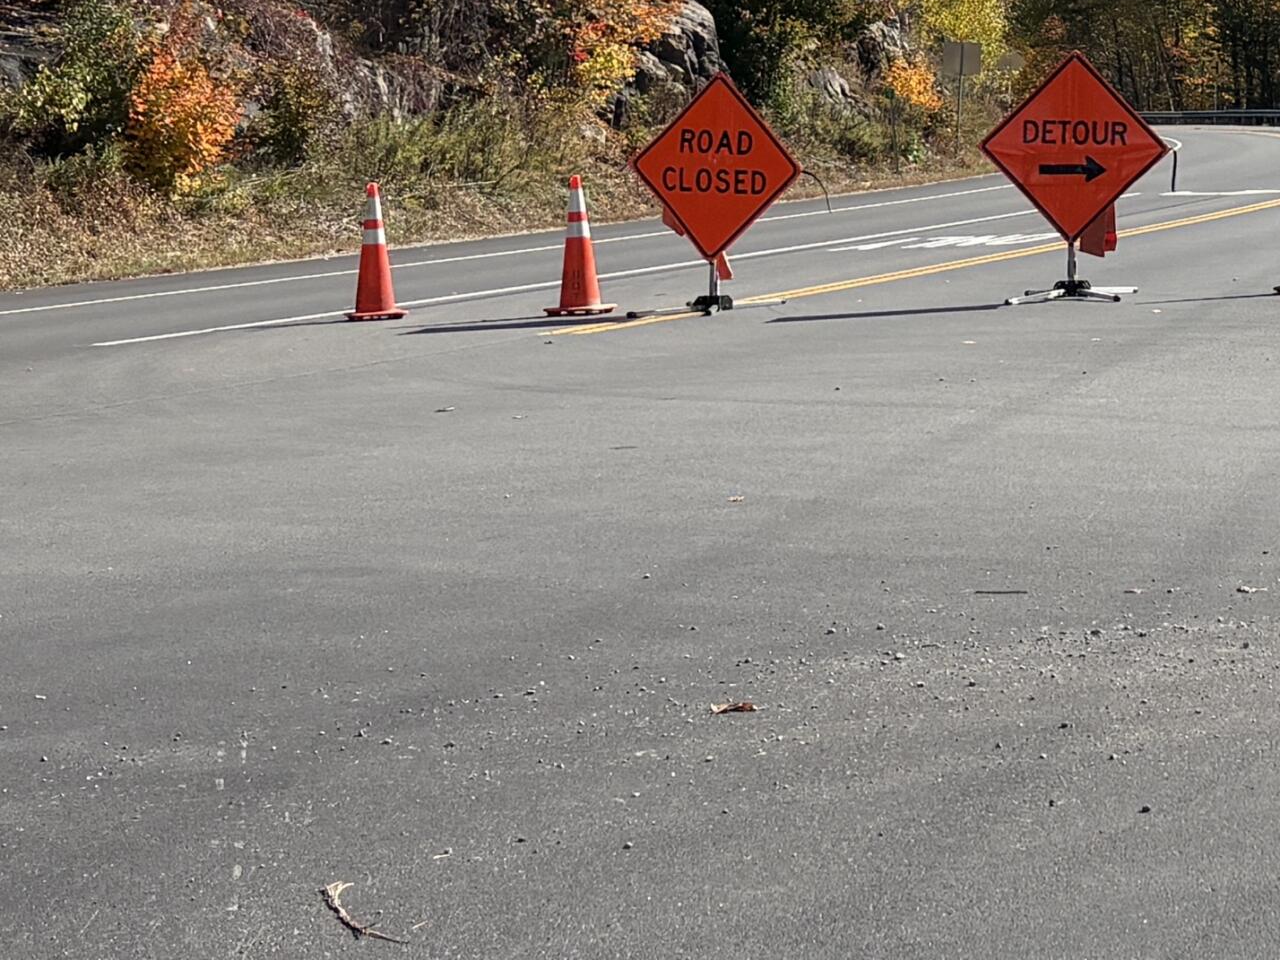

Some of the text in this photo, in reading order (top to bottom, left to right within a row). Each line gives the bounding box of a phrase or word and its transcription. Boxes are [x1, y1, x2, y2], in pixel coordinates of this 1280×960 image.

[679, 128, 753, 156] ROAD
[1022, 119, 1128, 145] DETOUR
[661, 166, 767, 195] CLOSED
